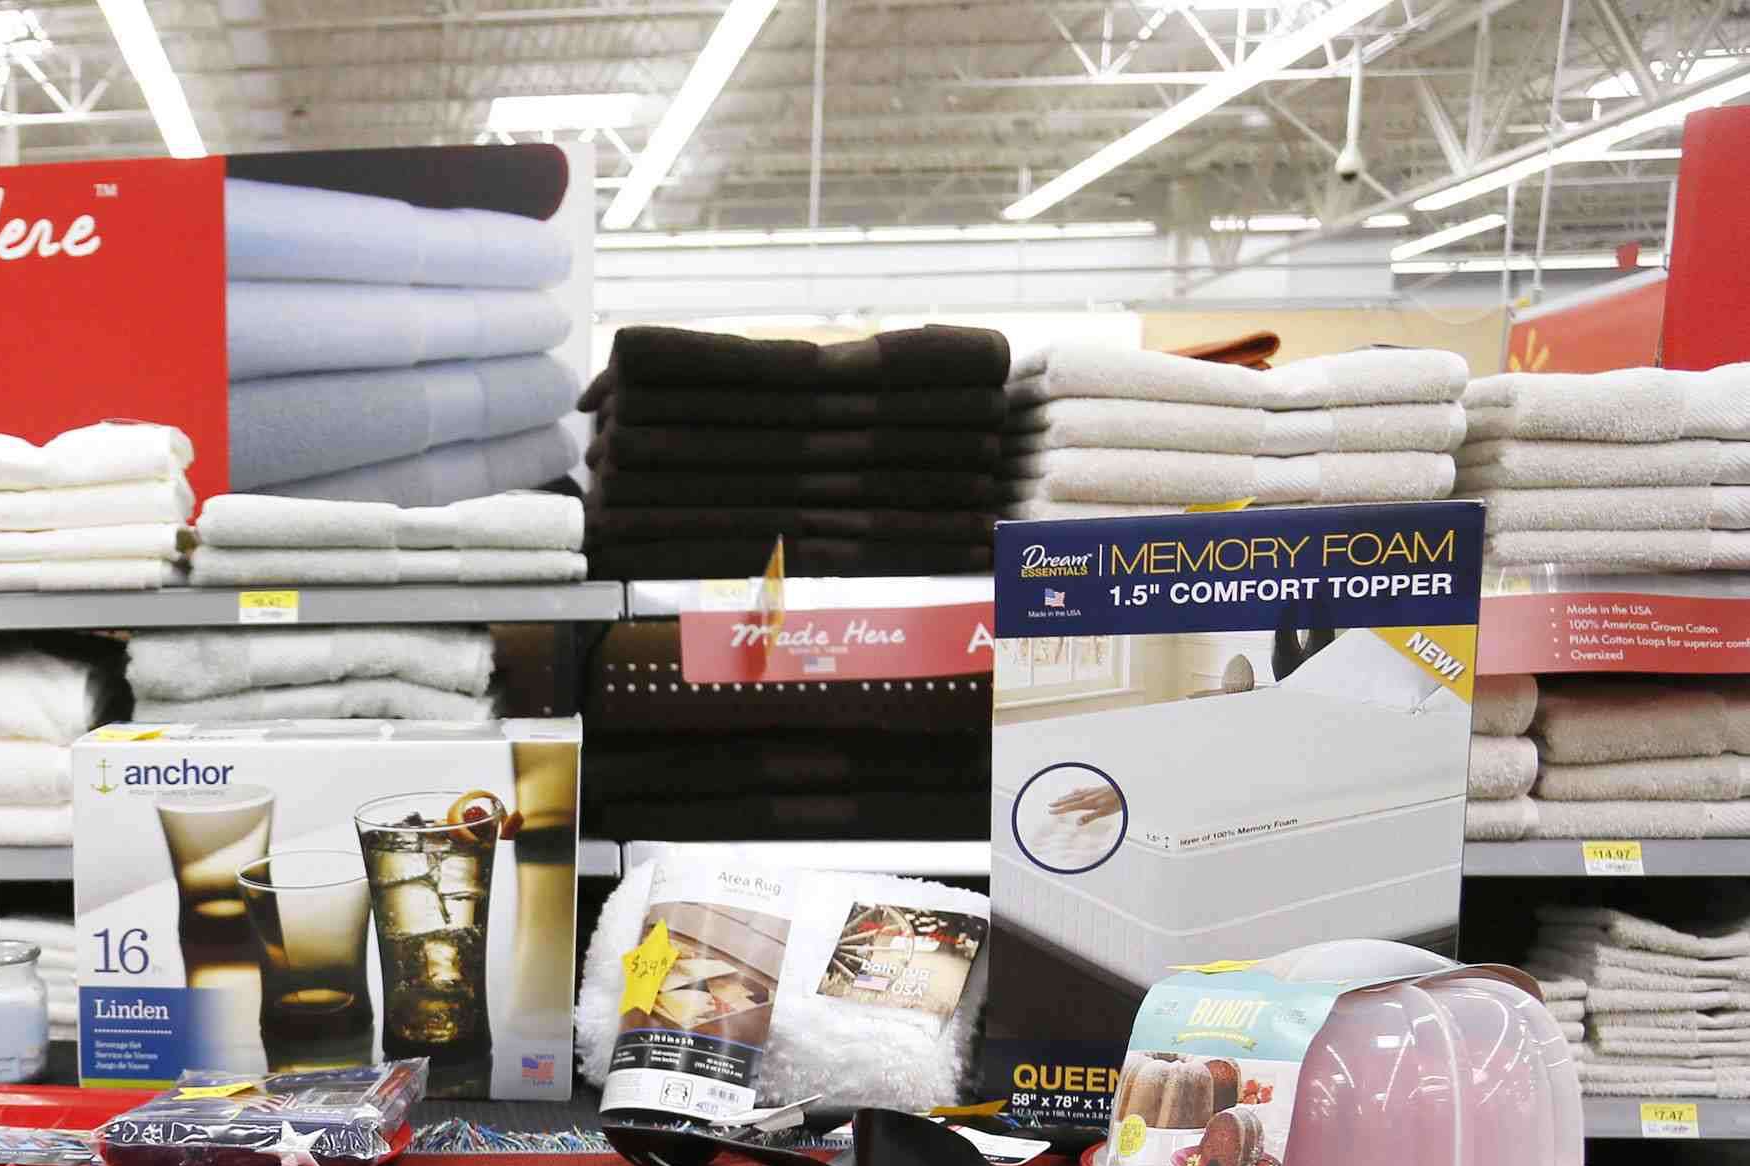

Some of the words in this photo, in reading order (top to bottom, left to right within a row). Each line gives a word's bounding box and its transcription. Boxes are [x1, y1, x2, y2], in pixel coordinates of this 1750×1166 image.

[1111, 536, 1310, 576] MEMORY
[1323, 529, 1455, 567] FOAM
[1021, 566, 1088, 578] ESSENTIALS
[1110, 584, 1160, 606] 1.5"
[1170, 577, 1320, 605] COMFORT
[1328, 573, 1452, 599] TOPPER
[1028, 610, 1046, 618] Made
[1066, 608, 1081, 616] USA
[1567, 604, 1597, 615] Made
[1600, 605, 1610, 615] in
[1612, 605, 1627, 615] the
[1630, 606, 1652, 616] USA
[843, 620, 906, 645] Here
[1569, 619, 1599, 631] 100%
[1602, 620, 1649, 631] American
[1650, 621, 1683, 634] Grown
[1686, 623, 1718, 634] Cotton
[1569, 634, 1599, 645] PIMA
[1601, 635, 1634, 646] Cotton
[1636, 636, 1665, 649] Loops
[1666, 635, 1681, 647] for
[1683, 638, 1724, 651] superior
[1405, 631, 1467, 682] NEW!
[1571, 650, 1624, 661] Oversized
[124, 758, 234, 785] anchor
[1237, 822, 1272, 836] Memory
[1274, 817, 1298, 828] Foam
[717, 872, 750, 886] Area
[754, 876, 782, 896] Rug
[93, 928, 149, 974] 16
[94, 999, 169, 1021] Linden
[1012, 1093, 1037, 1106] 58"
[1041, 1096, 1050, 1107] x
[1054, 1095, 1079, 1108] 78"
[1083, 1099, 1092, 1110] x
[1097, 1097, 1114, 1110] 1.
